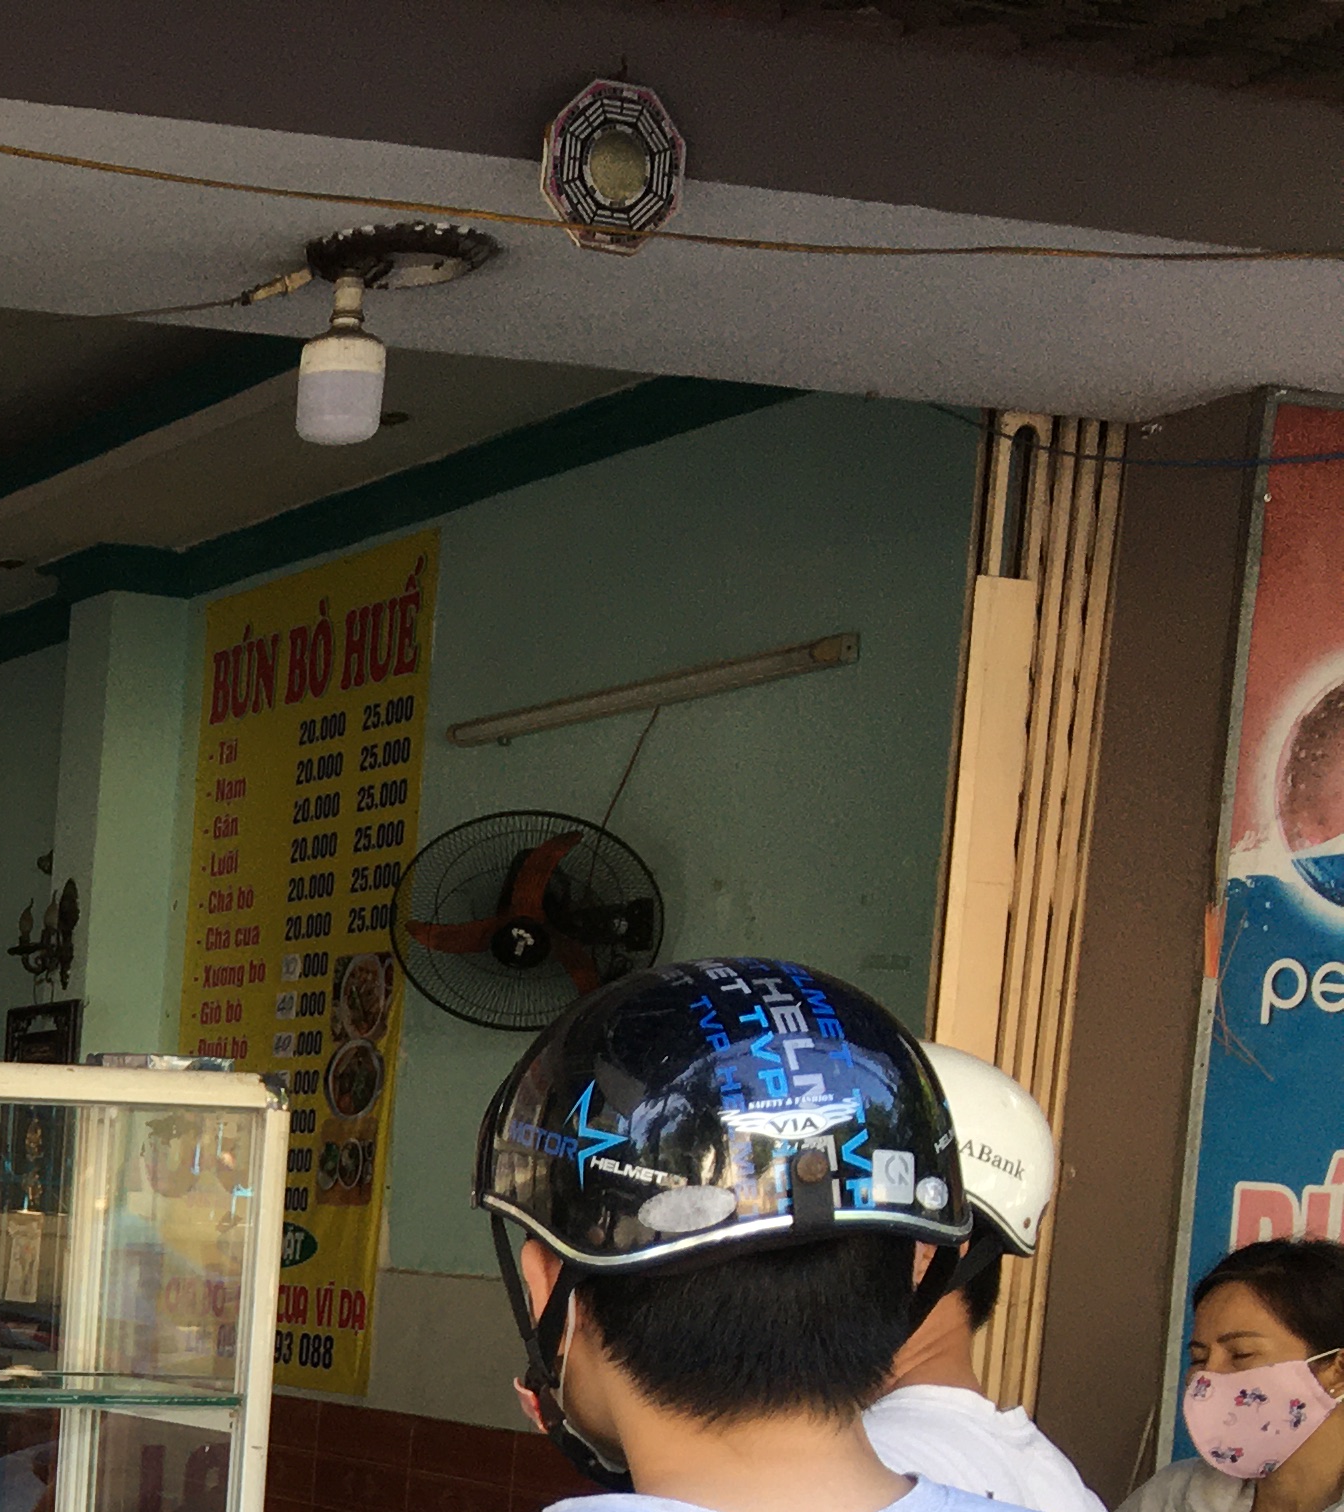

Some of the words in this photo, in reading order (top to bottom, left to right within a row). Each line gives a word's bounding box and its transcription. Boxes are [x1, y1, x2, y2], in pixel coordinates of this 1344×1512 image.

[210, 625, 279, 725] BÚN
[285, 598, 333, 704] BÒ
[341, 555, 425, 689] HUẾ
[299, 712, 346, 745] 20.000
[363, 695, 414, 730] 25.000
[296, 752, 343, 785] 20.000
[360, 737, 410, 772] 25.000
[293, 792, 340, 824] 20.000
[357, 779, 408, 812] 25.000
[290, 832, 337, 863] 20.000
[353, 821, 404, 852] 25.000
[287, 872, 334, 903] 20.000
[350, 862, 401, 893] 25.000
[285, 912, 331, 941] 20.000
[689, 994, 732, 1052] TVP
[509, 1119, 580, 1162] MOTOR
[769, 1116, 820, 1134] VIA
[590, 1155, 668, 1185] HELMET
[338, 1288, 366, 1337] DẠ
[299, 1332, 334, 1370] 088
